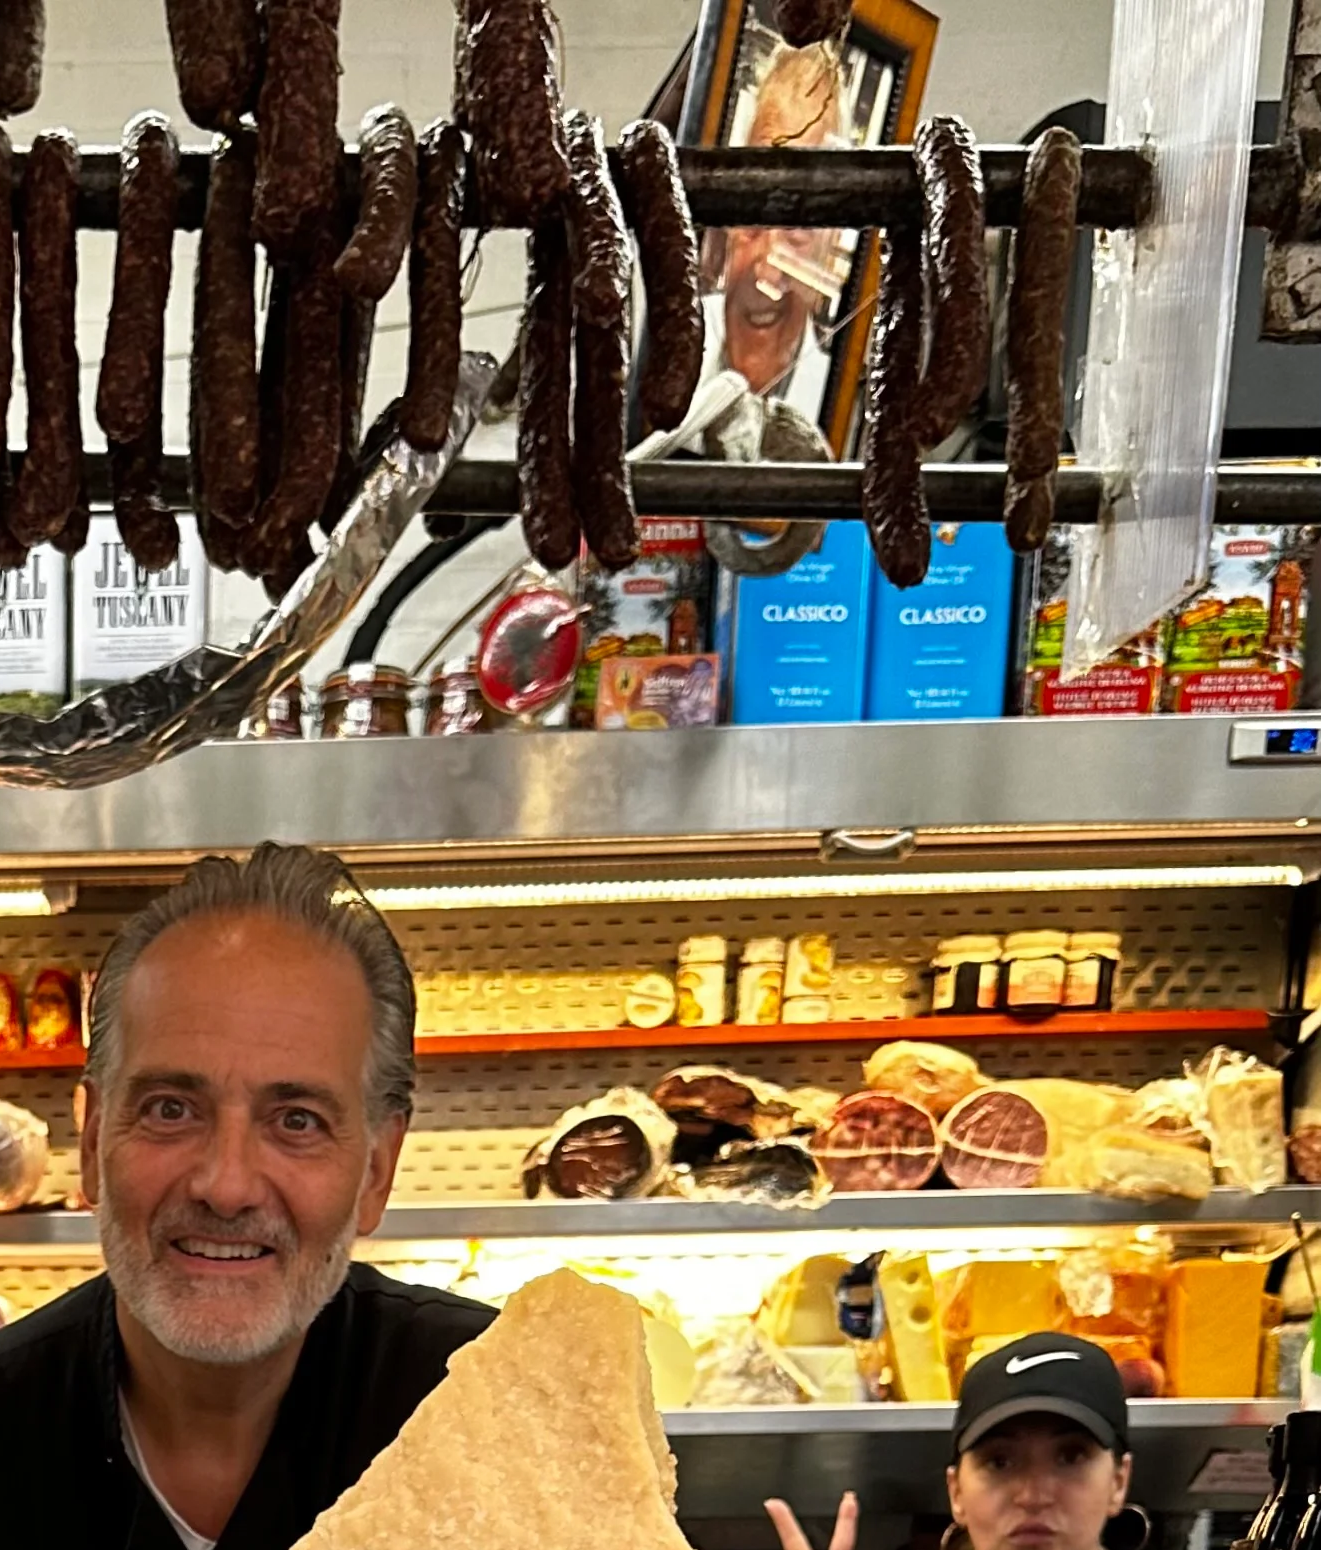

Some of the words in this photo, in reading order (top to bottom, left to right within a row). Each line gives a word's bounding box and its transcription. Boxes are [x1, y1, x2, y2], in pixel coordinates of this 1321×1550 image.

[93, 595, 190, 629] TUSCANY
[762, 604, 849, 623] CLASSICO
[899, 606, 987, 626] CLASSICO
